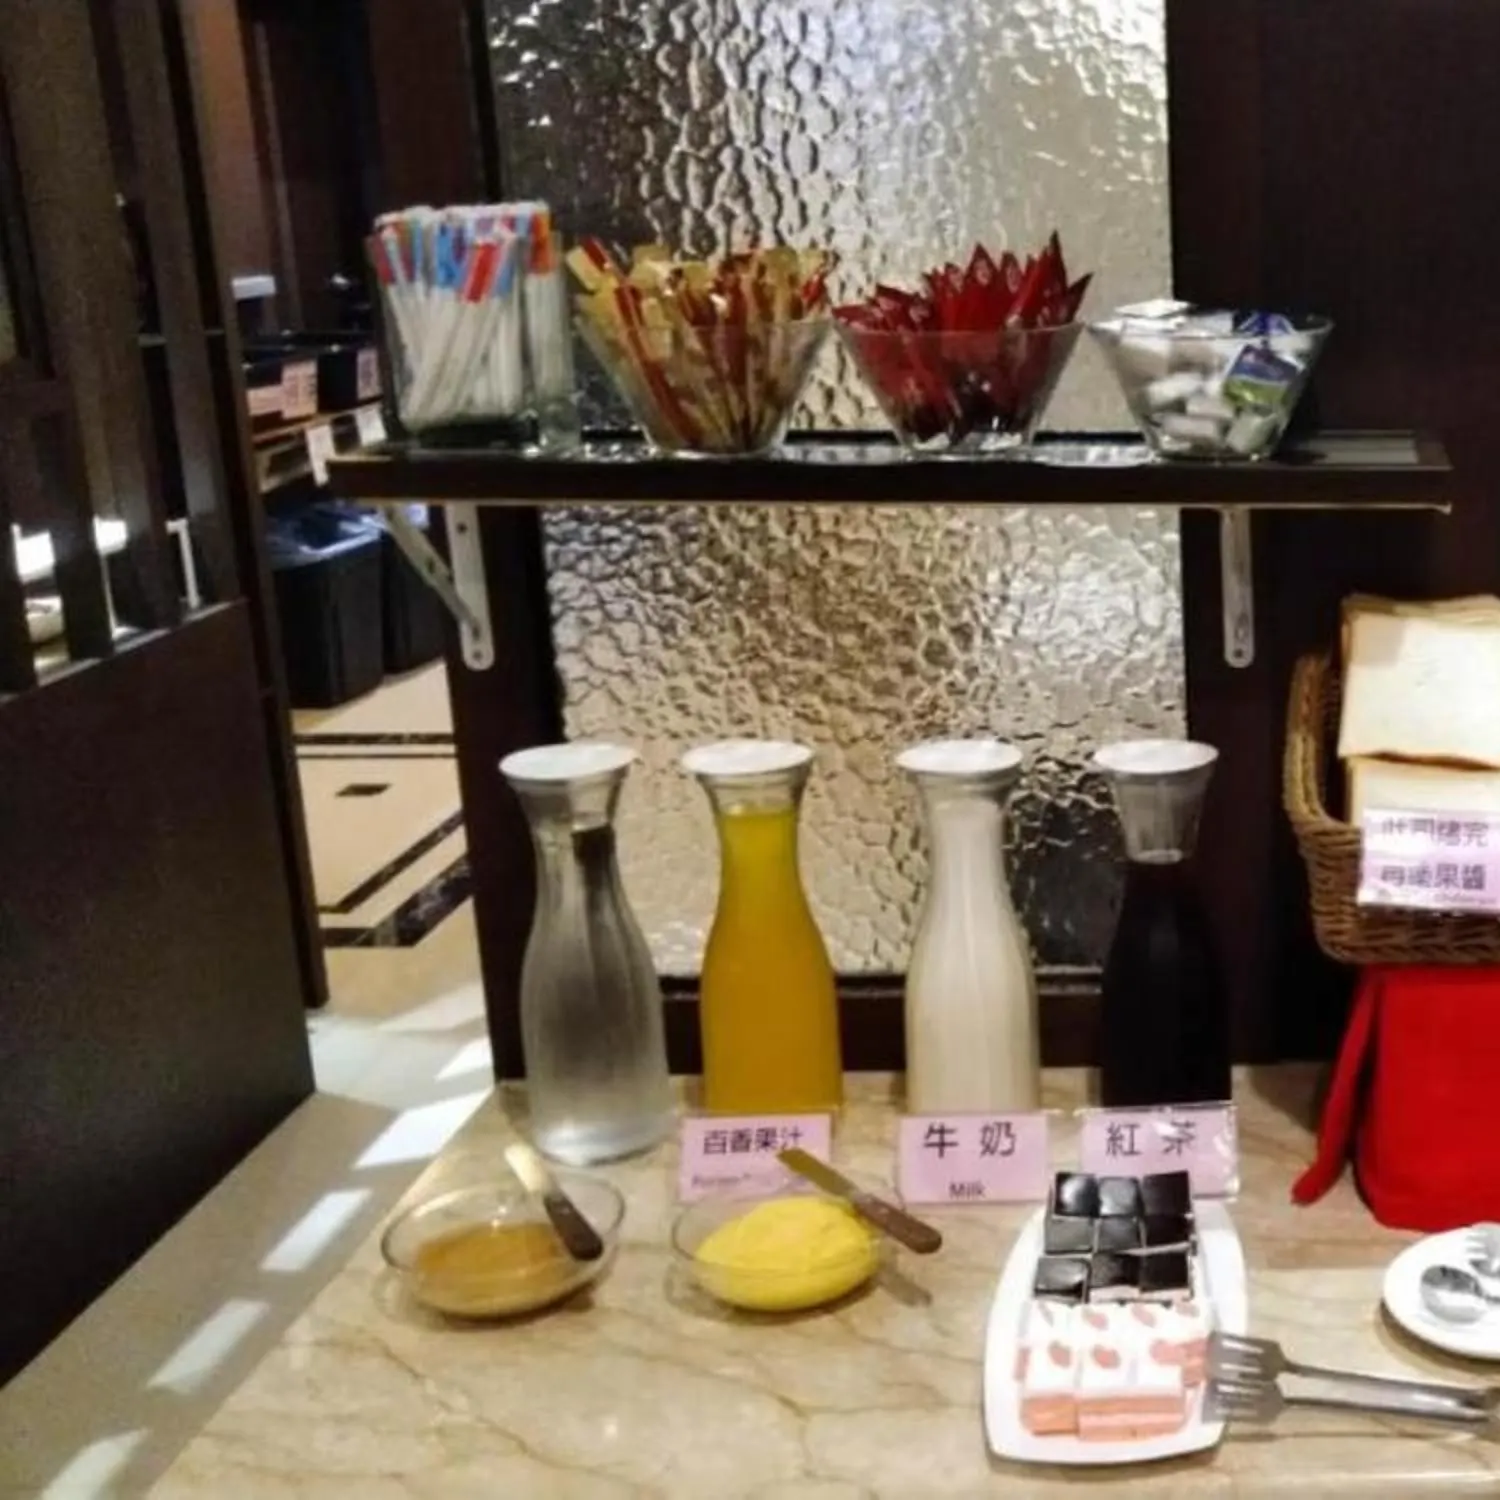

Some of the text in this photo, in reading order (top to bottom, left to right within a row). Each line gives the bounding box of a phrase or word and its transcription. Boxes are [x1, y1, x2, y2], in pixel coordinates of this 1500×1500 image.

[703, 1127, 802, 1155] 百香果汁
[923, 1120, 1016, 1159] 牛奶
[1105, 1120, 1197, 1157] 紅茶
[950, 1181, 986, 1197] Milk
